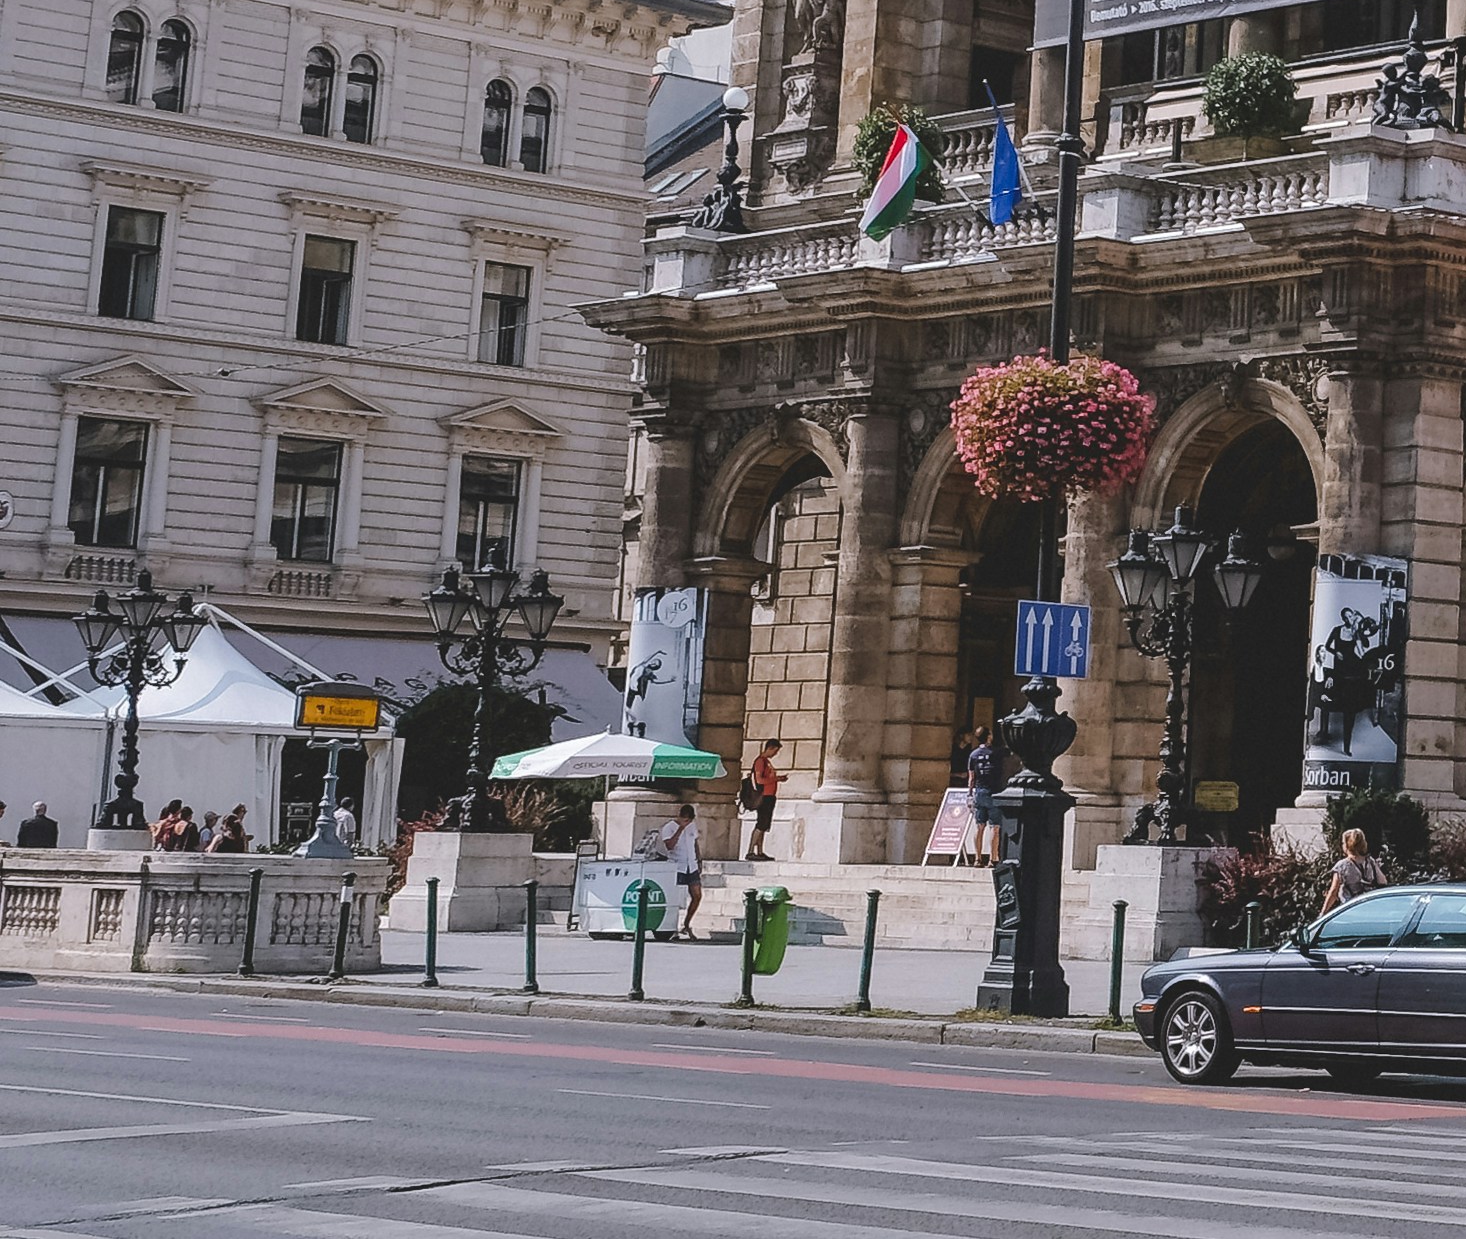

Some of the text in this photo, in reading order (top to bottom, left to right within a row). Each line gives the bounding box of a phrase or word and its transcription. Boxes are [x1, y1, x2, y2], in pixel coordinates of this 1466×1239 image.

[673, 597, 688, 612] 16
[1377, 653, 1395, 671] 16
[1367, 669, 1383, 685] 17
[612, 761, 649, 770] TOURIST
[654, 761, 713, 771] INFORMATION
[625, 891, 661, 902] PONT
